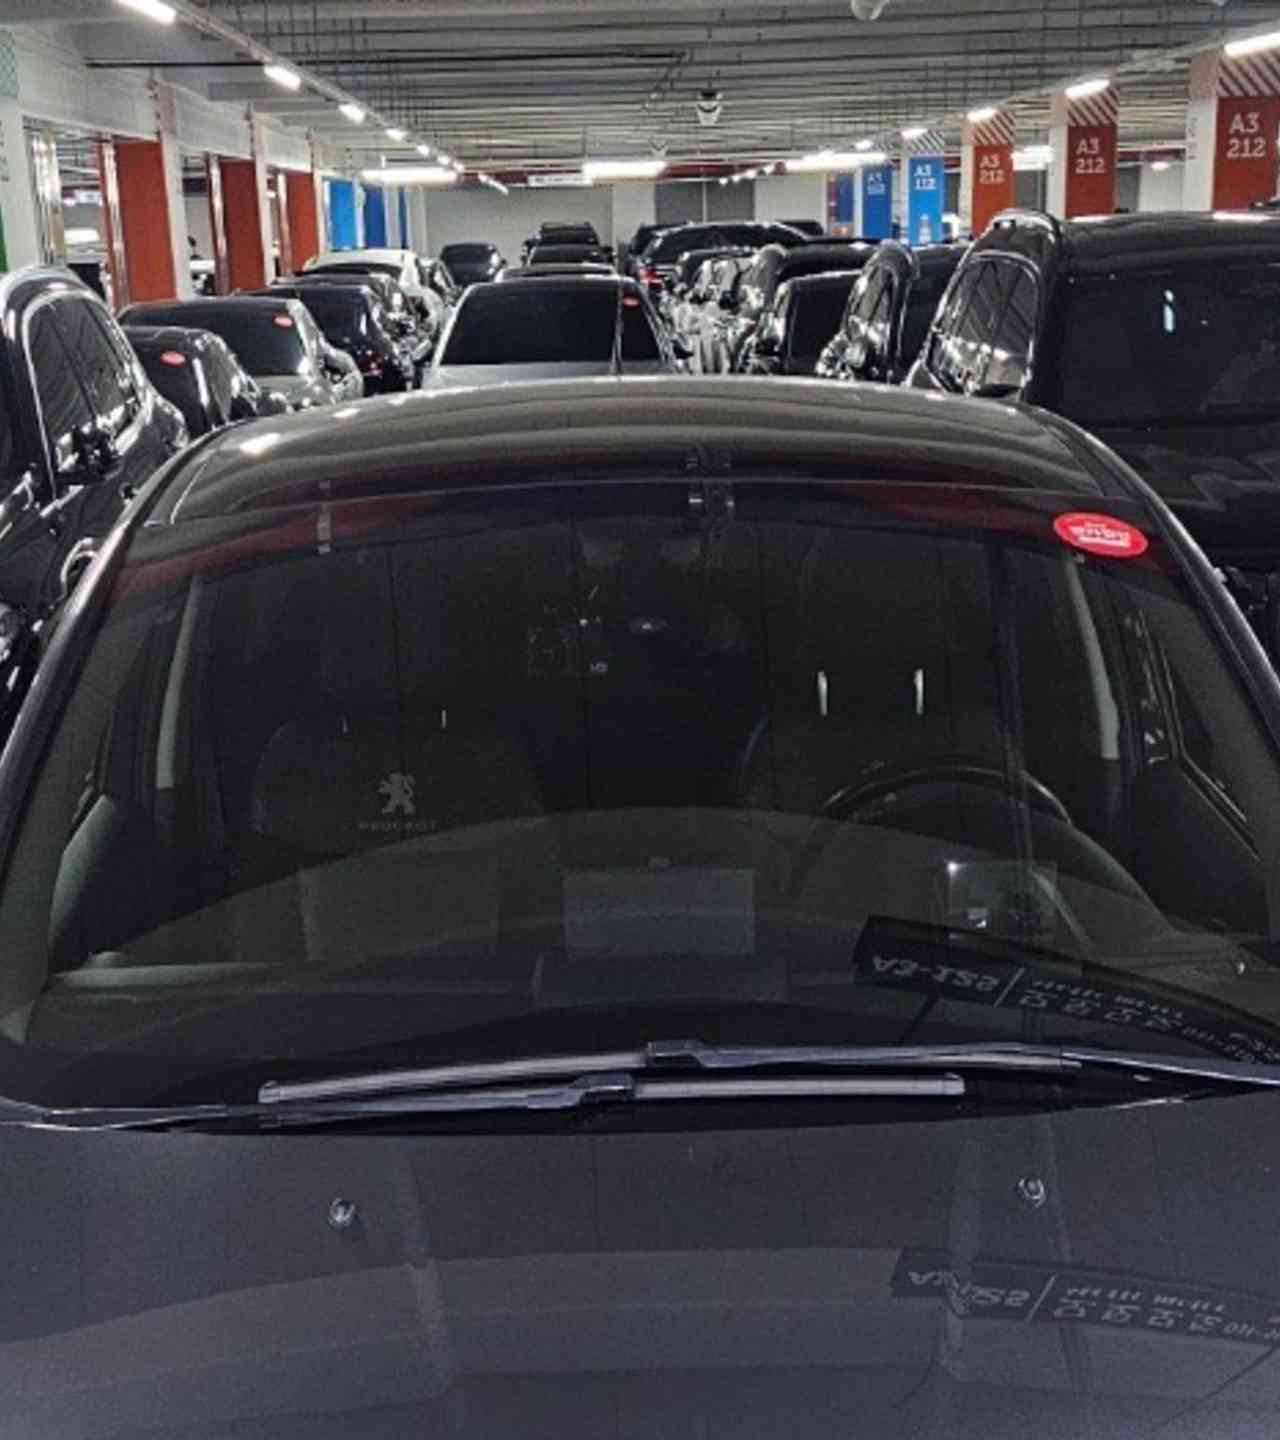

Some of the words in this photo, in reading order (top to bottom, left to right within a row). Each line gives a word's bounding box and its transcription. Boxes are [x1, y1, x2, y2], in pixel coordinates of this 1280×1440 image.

[1229, 112, 1260, 134] A3
[1076, 138, 1099, 154] A3
[1226, 137, 1266, 159] 212
[979, 154, 1001, 168] A3
[1075, 158, 1106, 174] 212
[979, 169, 1006, 184] 212
